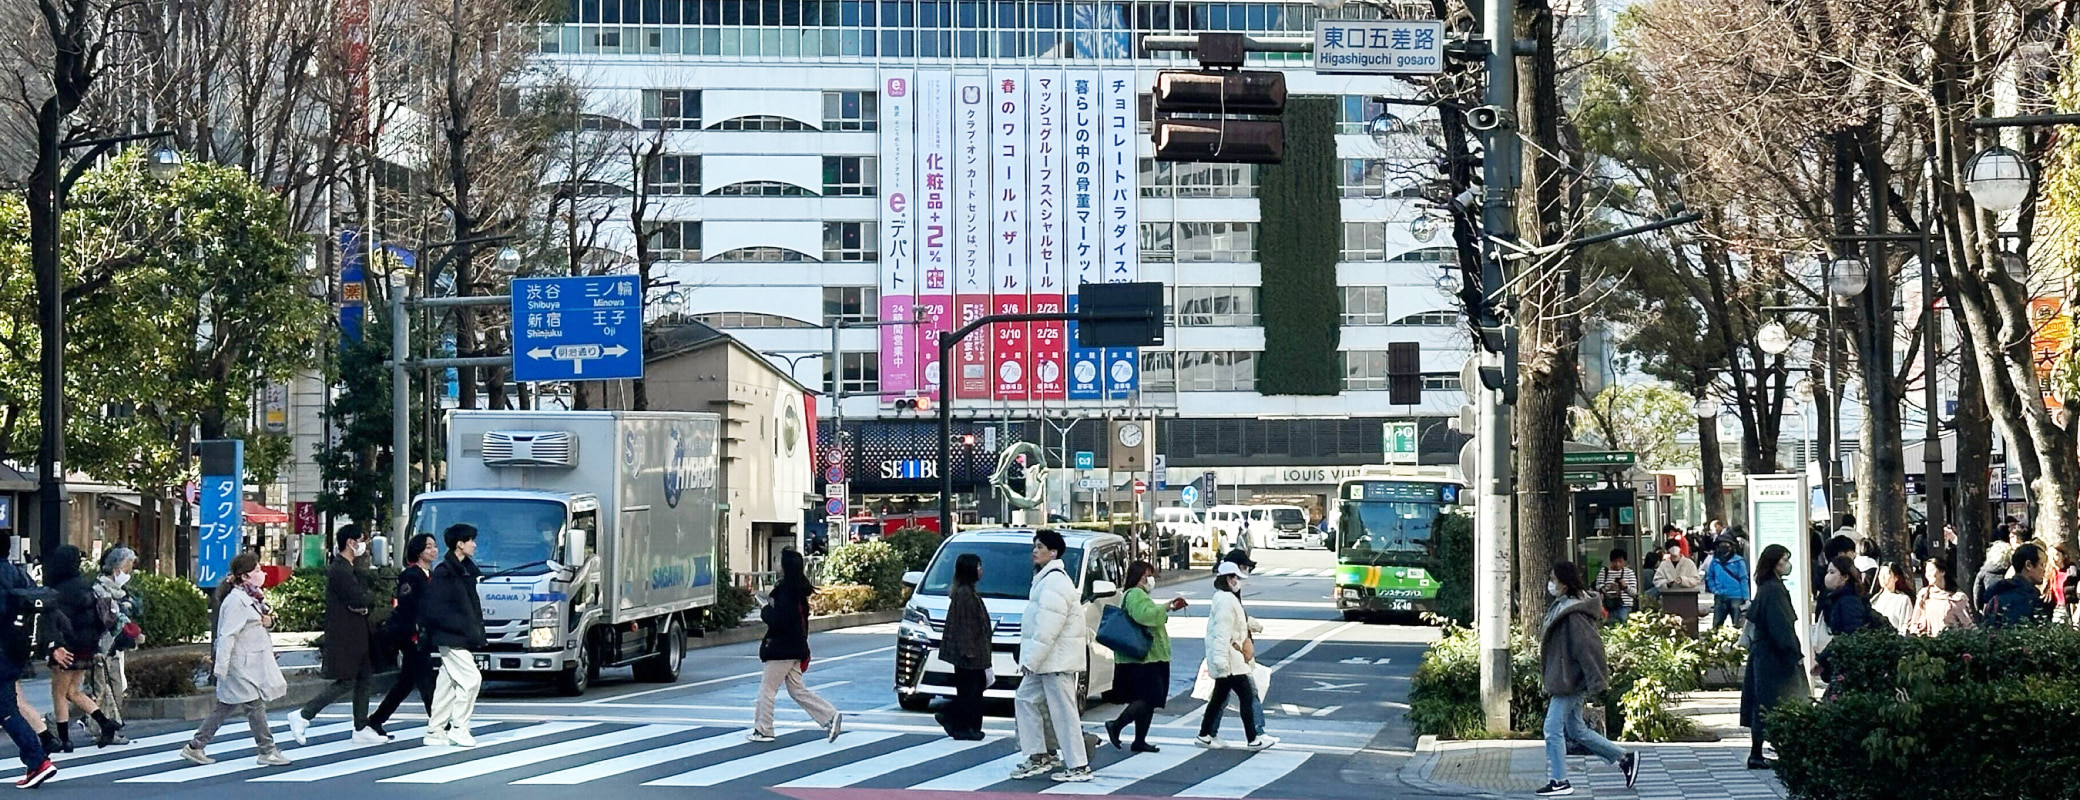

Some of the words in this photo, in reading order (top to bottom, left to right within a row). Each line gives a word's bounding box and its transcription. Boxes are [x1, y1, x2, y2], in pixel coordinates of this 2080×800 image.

[1323, 26, 1435, 50] 東口五差路
[1320, 52, 1392, 66] Higashiguchi
[1397, 55, 1436, 67] gosaro
[967, 169, 977, 199] カード
[1001, 79, 1017, 288] 春のワコールバザール
[1039, 78, 1053, 288] マッシュグループスペシャルセール
[1075, 79, 1091, 284] 暮らしの中の骨董マーケット
[1112, 79, 1127, 274] チョコレートパラダイス
[527, 284, 560, 300] 渋谷
[585, 281, 633, 297] 三ノ輪
[527, 301, 560, 310] Shibuya
[593, 299, 625, 307] Minowa
[1002, 304, 1018, 314] 3/6
[1037, 304, 1058, 314] 2/23
[527, 312, 561, 328] 新宿
[593, 310, 626, 326] 王子
[527, 329, 562, 339] Shinjuku
[603, 327, 616, 336] Oji
[1000, 329, 1021, 339] 3/10
[1037, 329, 1058, 339] 2/25
[558, 347, 597, 357] 明治通り
[675, 456, 714, 490] HYBRID
[1283, 470, 1325, 481] LOUIS
[218, 481, 234, 560] タクシー
[199, 522, 218, 583] プール
[652, 565, 684, 590] SAGAWA
